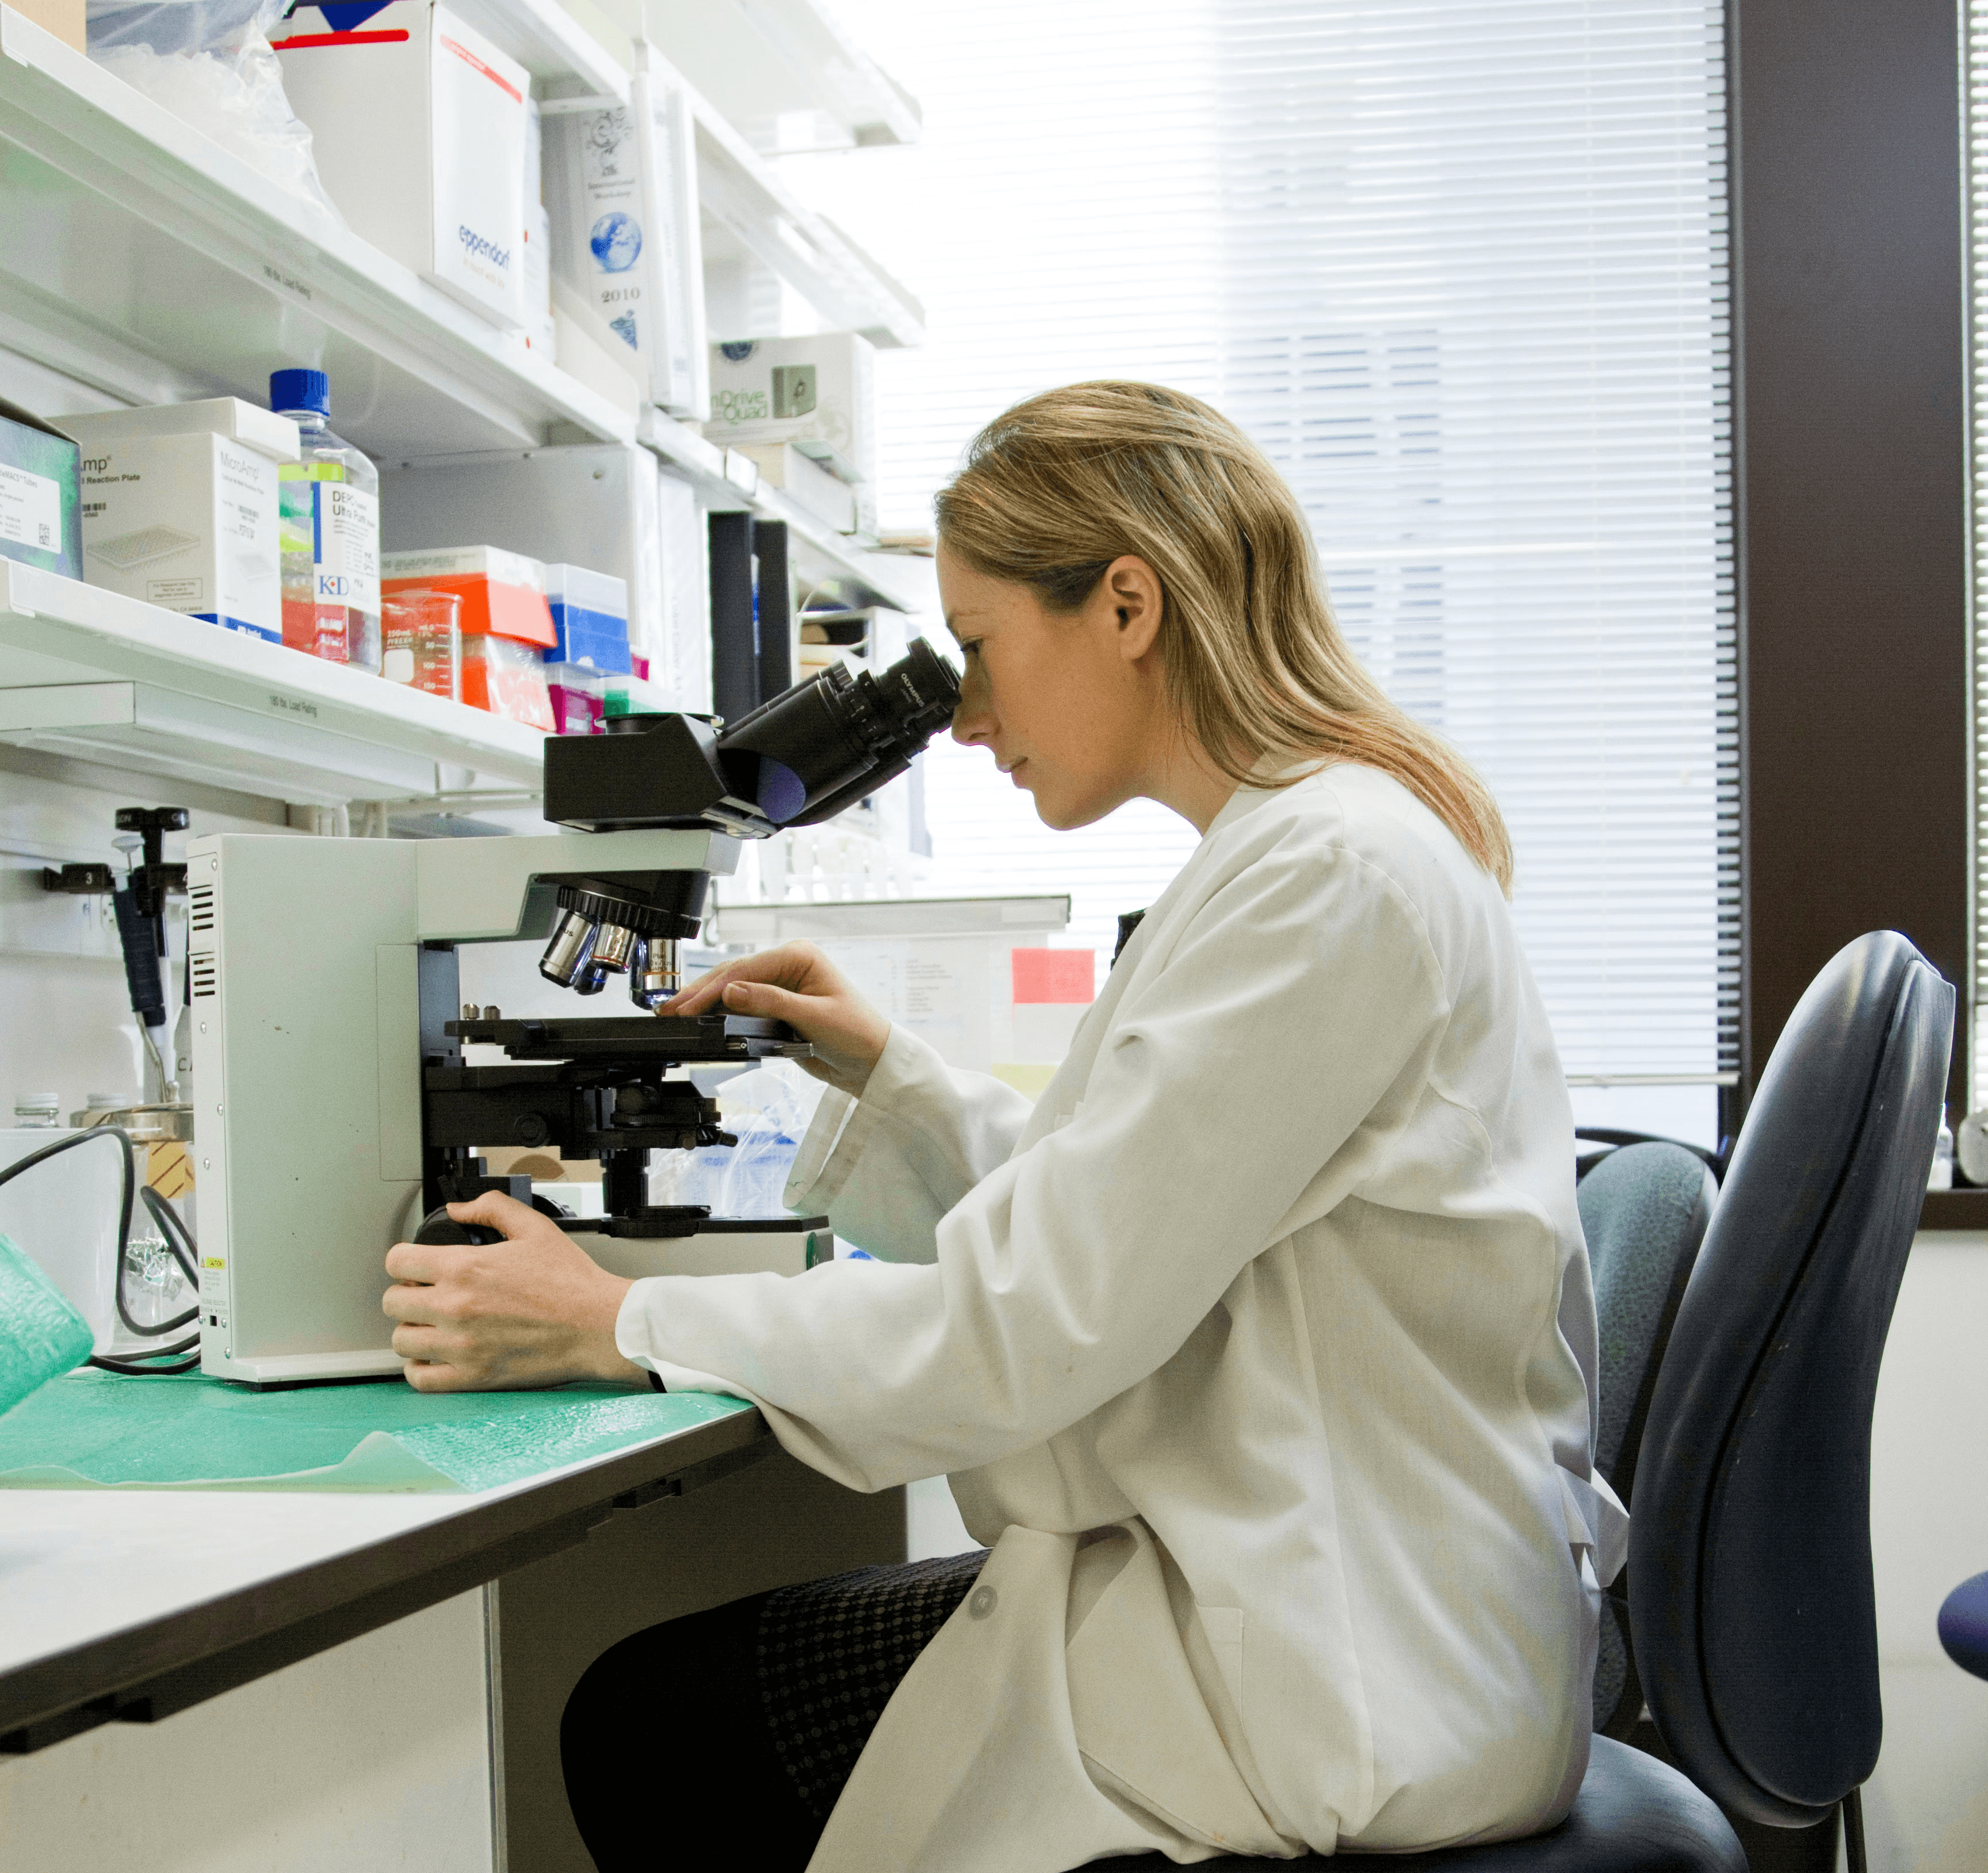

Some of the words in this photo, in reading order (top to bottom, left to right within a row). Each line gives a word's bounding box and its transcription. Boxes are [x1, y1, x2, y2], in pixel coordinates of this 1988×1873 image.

[587, 178, 635, 190] International
[460, 225, 510, 271] eppendorf
[601, 288, 640, 303] 2010
[722, 403, 767, 425] Quad
[24, 476, 37, 488] Tubes
[87, 476, 120, 484] Reaction
[333, 490, 355, 506] DEPC
[333, 504, 352, 519] Ultra
[354, 510, 366, 524] Pure
[388, 629, 411, 637] 250mL
[426, 641, 435, 649] 50
[423, 662, 435, 670] 100
[423, 682, 436, 690] 150
[901, 673, 925, 707] OLYMPUS
[289, 698, 301, 711] Load
[301, 702, 317, 718] Rating
[86, 872, 93, 885] 3
